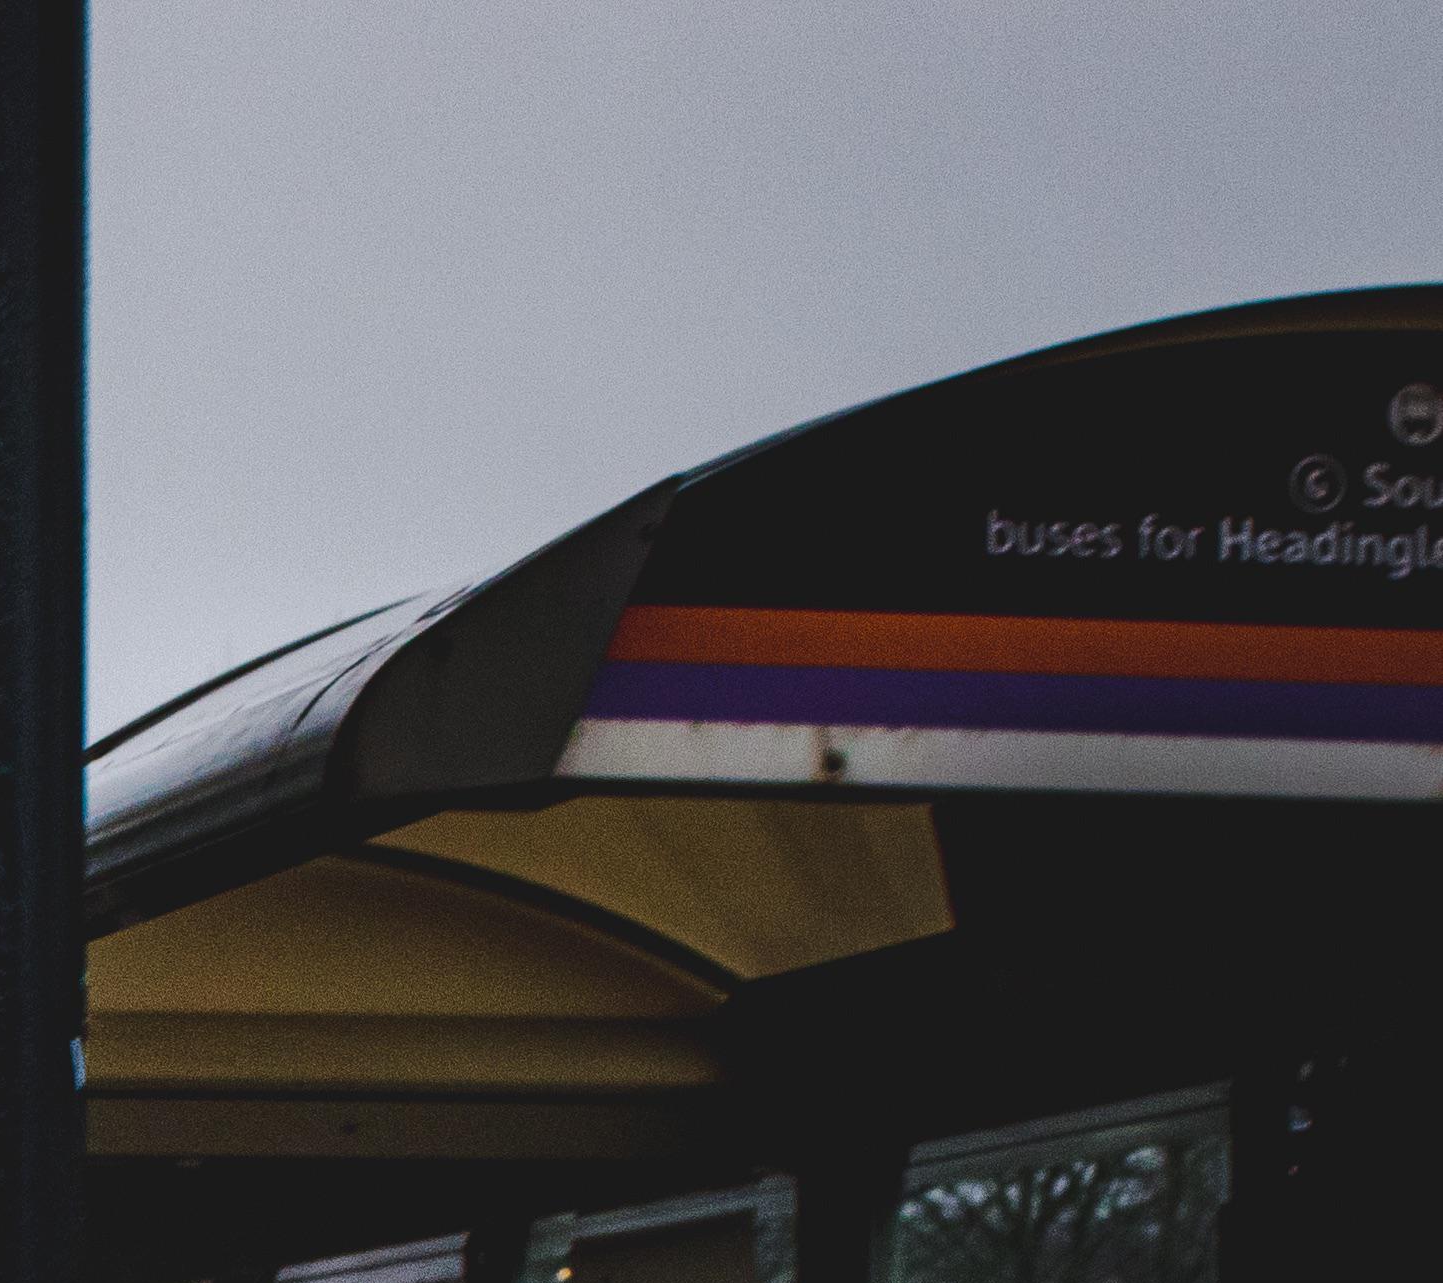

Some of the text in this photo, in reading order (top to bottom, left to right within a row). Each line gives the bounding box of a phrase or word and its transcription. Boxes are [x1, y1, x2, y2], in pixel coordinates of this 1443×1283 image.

[1363, 462, 1443, 509] Sou
[987, 509, 1122, 558] buses
[1138, 513, 1205, 559] for
